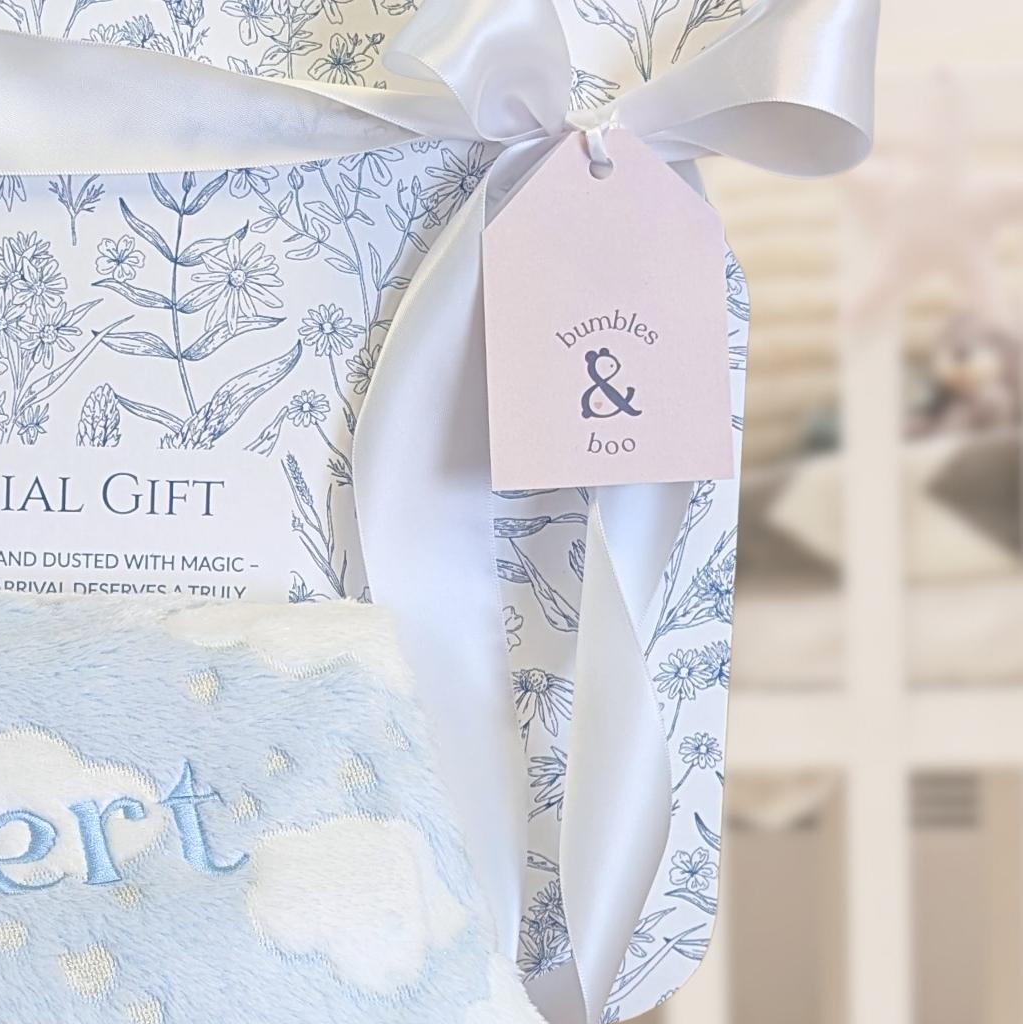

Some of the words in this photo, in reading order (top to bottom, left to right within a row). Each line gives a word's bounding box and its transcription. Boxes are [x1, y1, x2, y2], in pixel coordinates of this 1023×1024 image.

[555, 309, 659, 348] bumbles
[586, 432, 636, 455] boo
[102, 472, 225, 518] GIFT
[42, 552, 119, 569] DUSTED
[124, 553, 175, 571] WITH
[181, 556, 245, 573] MAGIC
